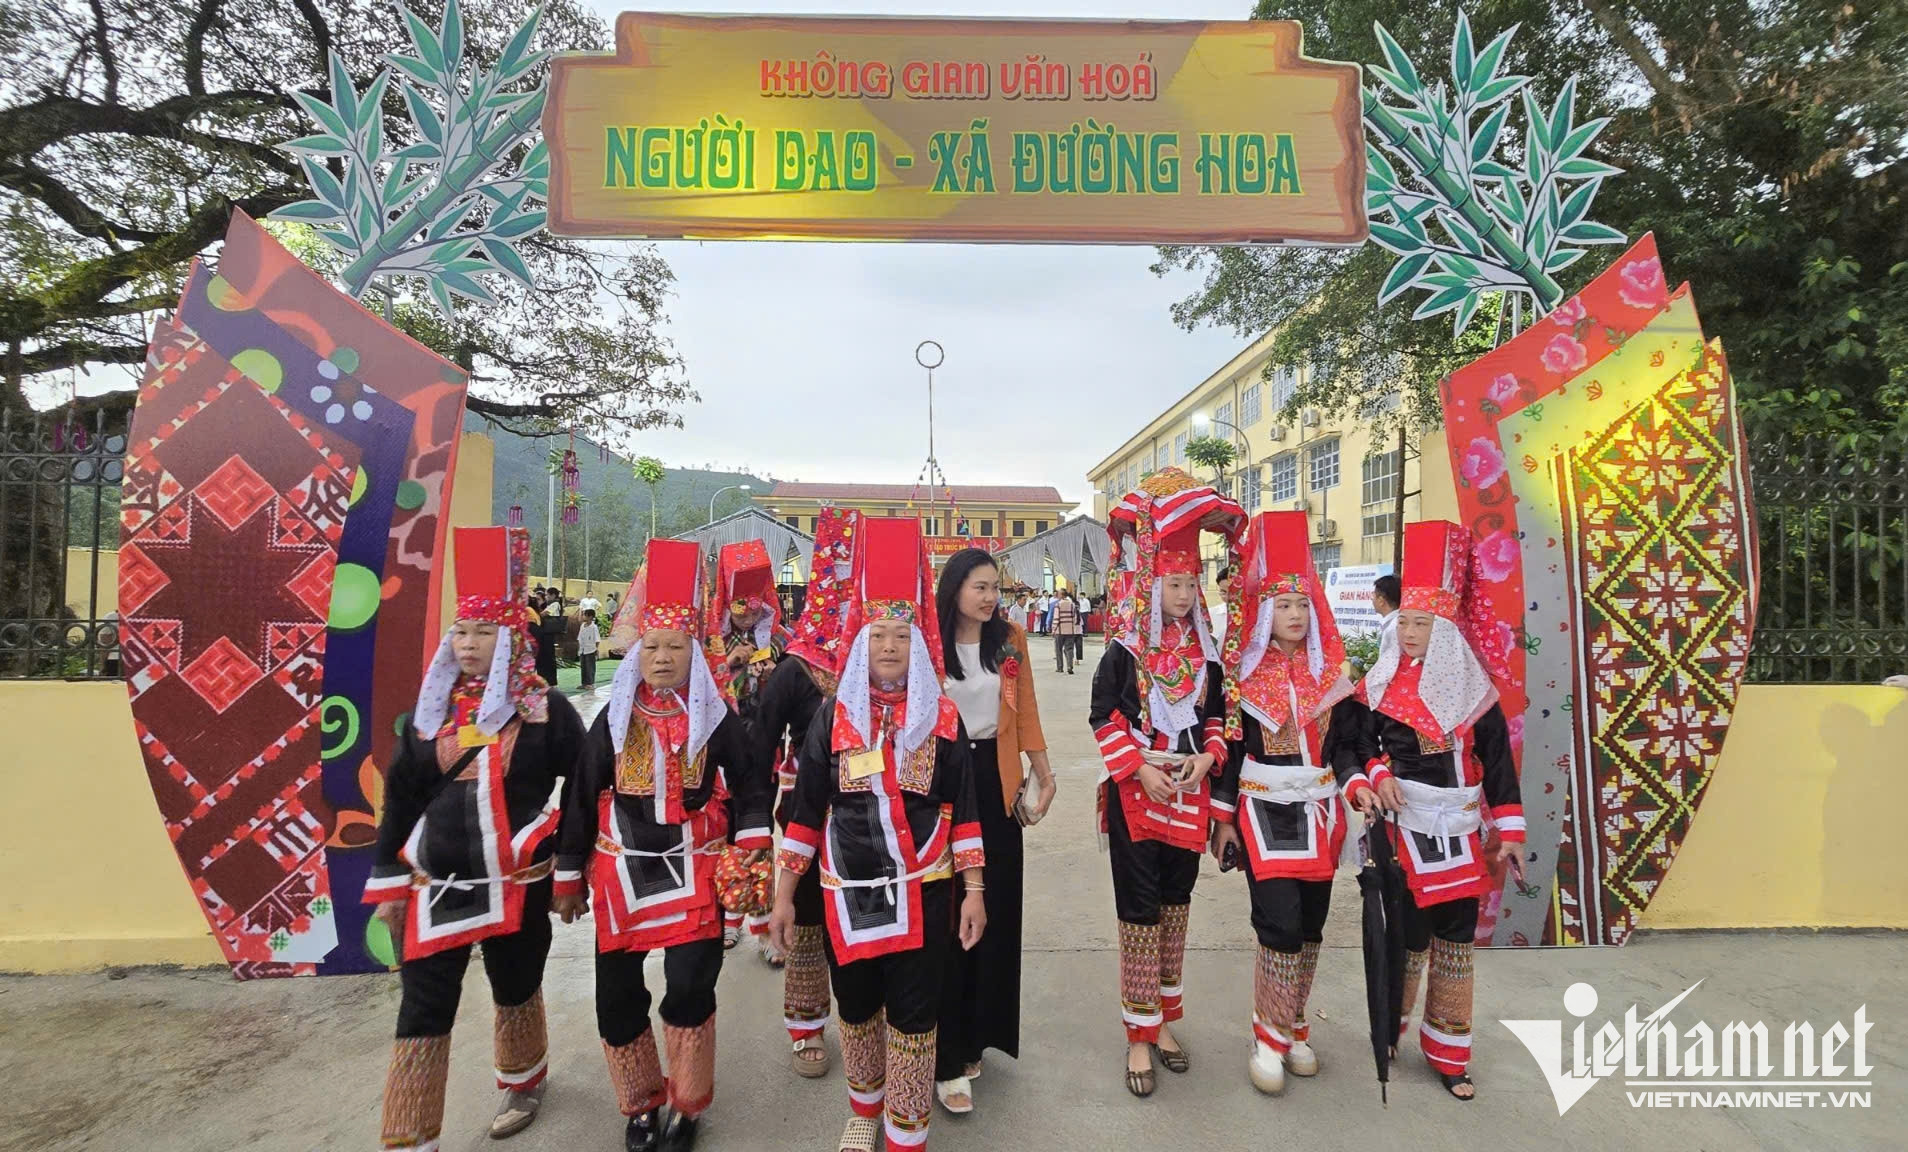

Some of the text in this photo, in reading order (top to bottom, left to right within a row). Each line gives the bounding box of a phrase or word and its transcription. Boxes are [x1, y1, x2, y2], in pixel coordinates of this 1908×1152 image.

[761, 50, 1154, 97] KHÔNG GIAN VĂN HOÁ
[604, 113, 756, 190] NGƯỜI
[775, 130, 878, 192] DAO
[930, 118, 996, 194] XÃ
[1011, 118, 1181, 194] ĐƯỜNG
[1195, 133, 1304, 195] HOA
[1339, 591, 1355, 601] GIAN
